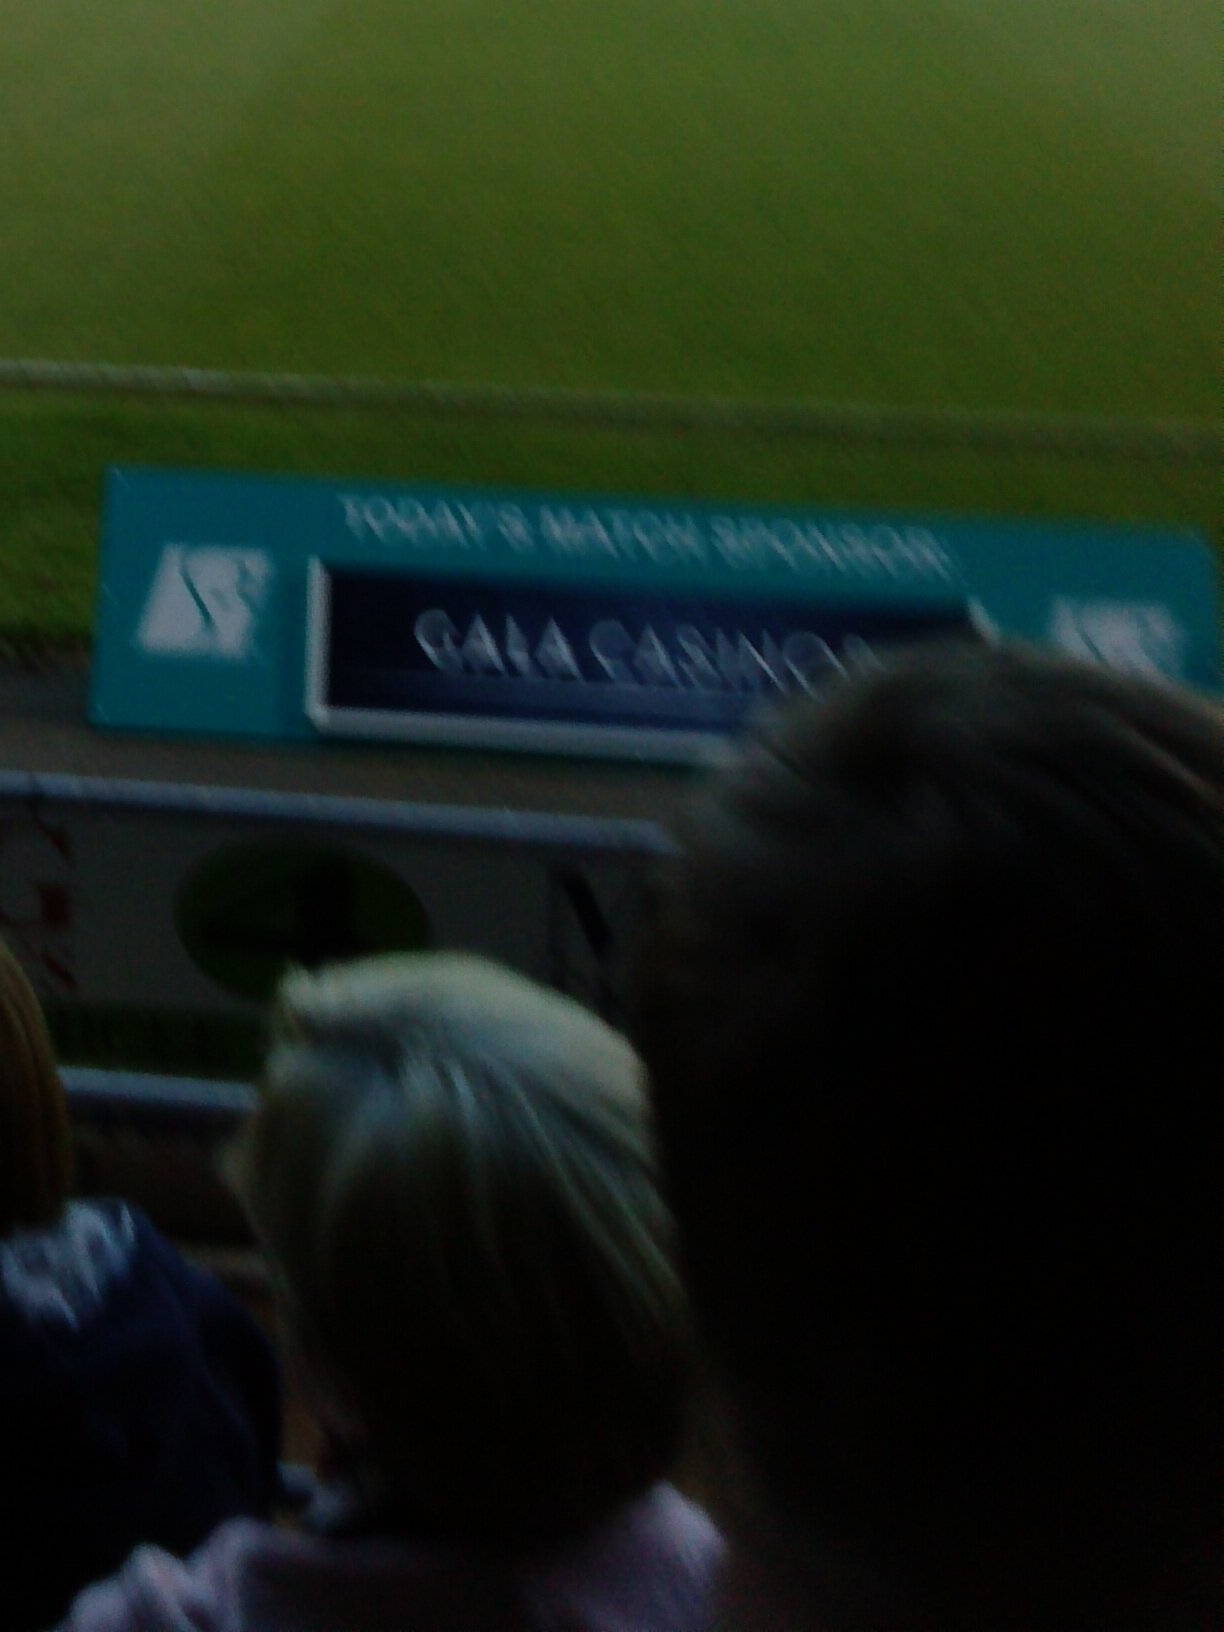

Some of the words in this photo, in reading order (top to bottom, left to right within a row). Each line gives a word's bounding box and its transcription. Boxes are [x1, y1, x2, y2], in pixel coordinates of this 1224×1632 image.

[337, 493, 533, 555] TODAY'S
[539, 503, 707, 563] MATCH
[416, 608, 588, 684] GALA
